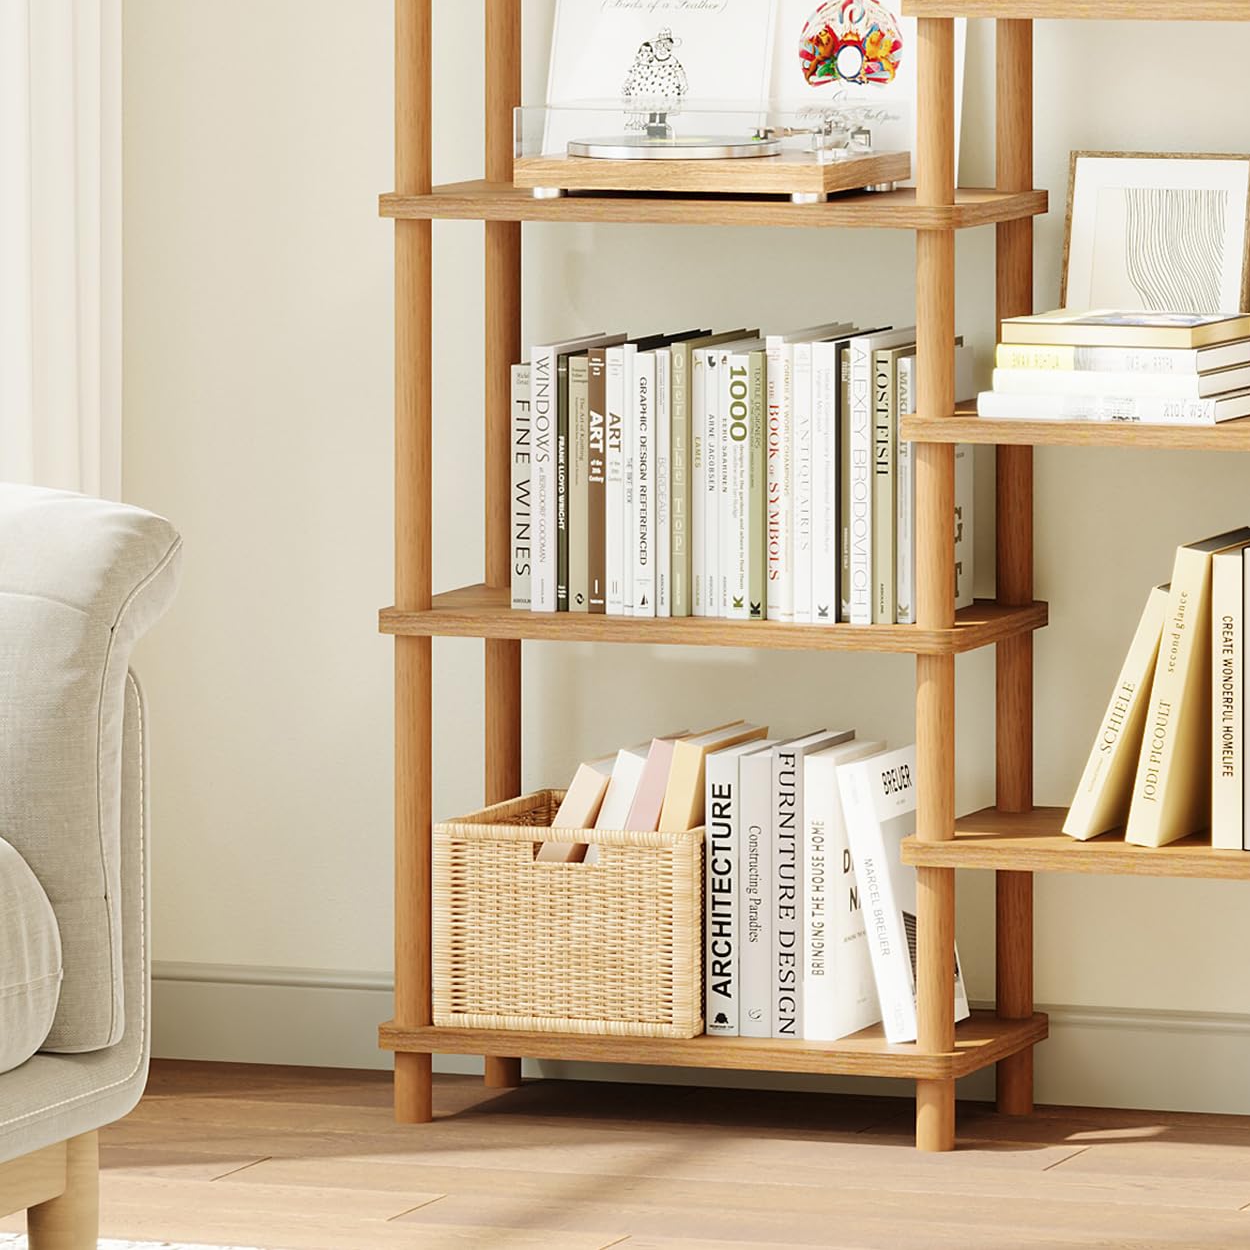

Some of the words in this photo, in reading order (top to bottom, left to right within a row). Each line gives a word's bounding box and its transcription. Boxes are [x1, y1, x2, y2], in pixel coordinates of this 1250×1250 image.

[535, 356, 550, 463] WINDOWS
[639, 377, 648, 431] GRAPHIC
[730, 366, 747, 442] 1000
[853, 347, 867, 440] ALEXEY
[876, 359, 888, 419] LOST
[515, 400, 531, 465] FINE
[590, 411, 604, 453] ART
[609, 412, 622, 452] ART
[639, 435, 648, 480] DESIGN
[769, 405, 779, 459] BOOK
[876, 425, 888, 475] FISH
[515, 479, 531, 576] WINES
[639, 485, 648, 566] REFERENCED
[769, 482, 779, 581] SYMBOLS
[853, 449, 867, 606] BRODOVITCH
[1168, 631, 1181, 673] second
[1175, 591, 1188, 629] glance
[1222, 615, 1233, 655] CREATE
[1101, 681, 1136, 754] SCHIELE
[1222, 658, 1233, 721] WONDERFUL
[1150, 699, 1171, 763] PICOULT
[1222, 724, 1233, 777] HOMELIFE
[882, 764, 912, 795] BREUER
[1143, 768, 1159, 801] JODI
[747, 825, 762, 894] Constructing
[778, 753, 796, 920] FURNITURE
[812, 820, 825, 851] HOME
[712, 783, 732, 998] ARCHITECTURE
[812, 853, 825, 893] HOUSE
[812, 895, 825, 918] THE
[812, 919, 825, 976] BRINGING
[778, 930, 796, 1036] DESIGN
